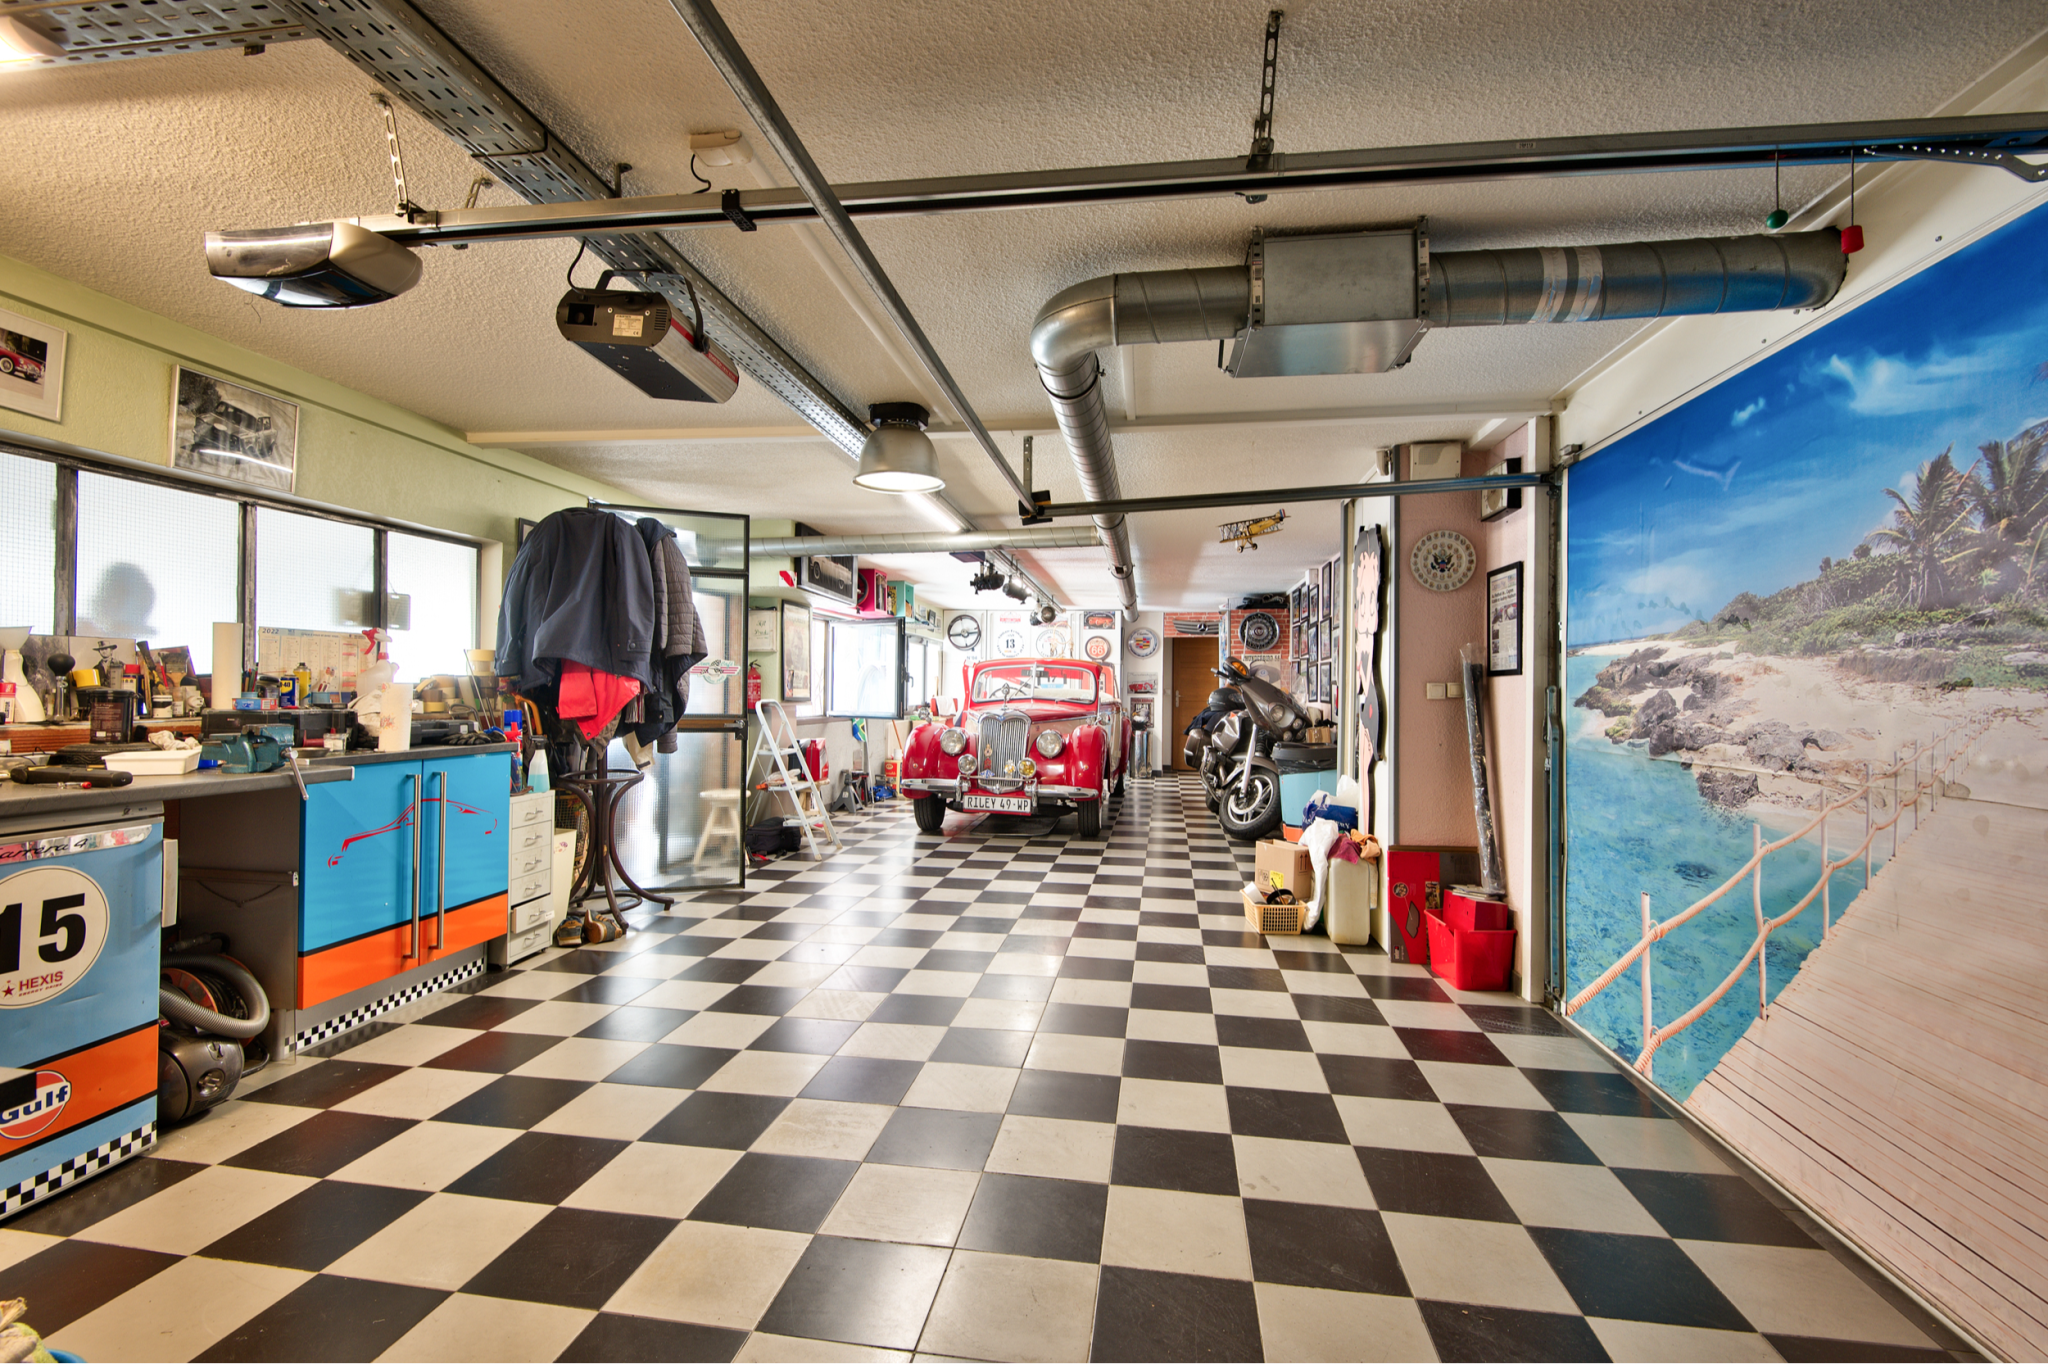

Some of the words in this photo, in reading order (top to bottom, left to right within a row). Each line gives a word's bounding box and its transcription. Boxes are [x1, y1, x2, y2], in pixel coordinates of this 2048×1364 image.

[1005, 638, 1016, 649] 13
[1091, 645, 1104, 655] 66
[967, 796, 997, 809] RILEY
[0, 844, 69, 859] arrera
[73, 838, 89, 849] 4
[0, 892, 87, 975] 15
[18, 970, 64, 992] HEXIS
[0, 1084, 69, 1125] Gulf
